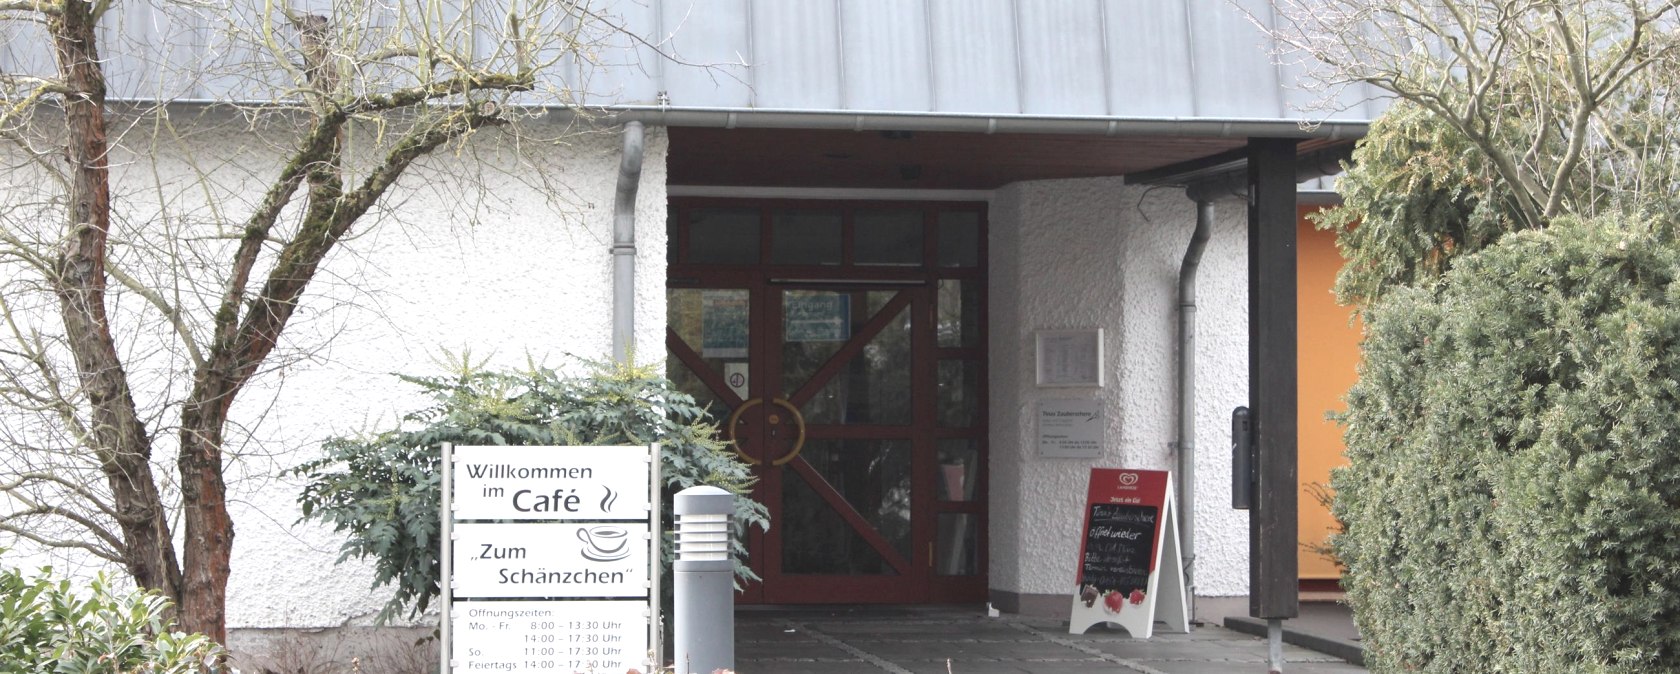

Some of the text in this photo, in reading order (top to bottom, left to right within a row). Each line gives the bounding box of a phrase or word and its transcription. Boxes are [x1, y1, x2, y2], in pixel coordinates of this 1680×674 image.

[466, 463, 592, 479] Willkommen
[483, 483, 581, 513] im Café
[1110, 527, 1142, 541] wieder
[468, 621, 488, 631] Mo.
[499, 621, 511, 631] Fr.
[530, 621, 555, 630] 8:00
[569, 621, 599, 630] 13:30
[602, 620, 622, 629] Uhr
[525, 634, 555, 643] 14:00
[569, 634, 599, 643] 17:30
[602, 633, 622, 642] Uhr
[525, 647, 555, 656] 11:00
[569, 647, 599, 656] 17:30
[602, 646, 622, 655] Uhr
[468, 660, 517, 672] Feiertags
[525, 660, 555, 669] 14:00
[602, 659, 622, 668] Uhr
